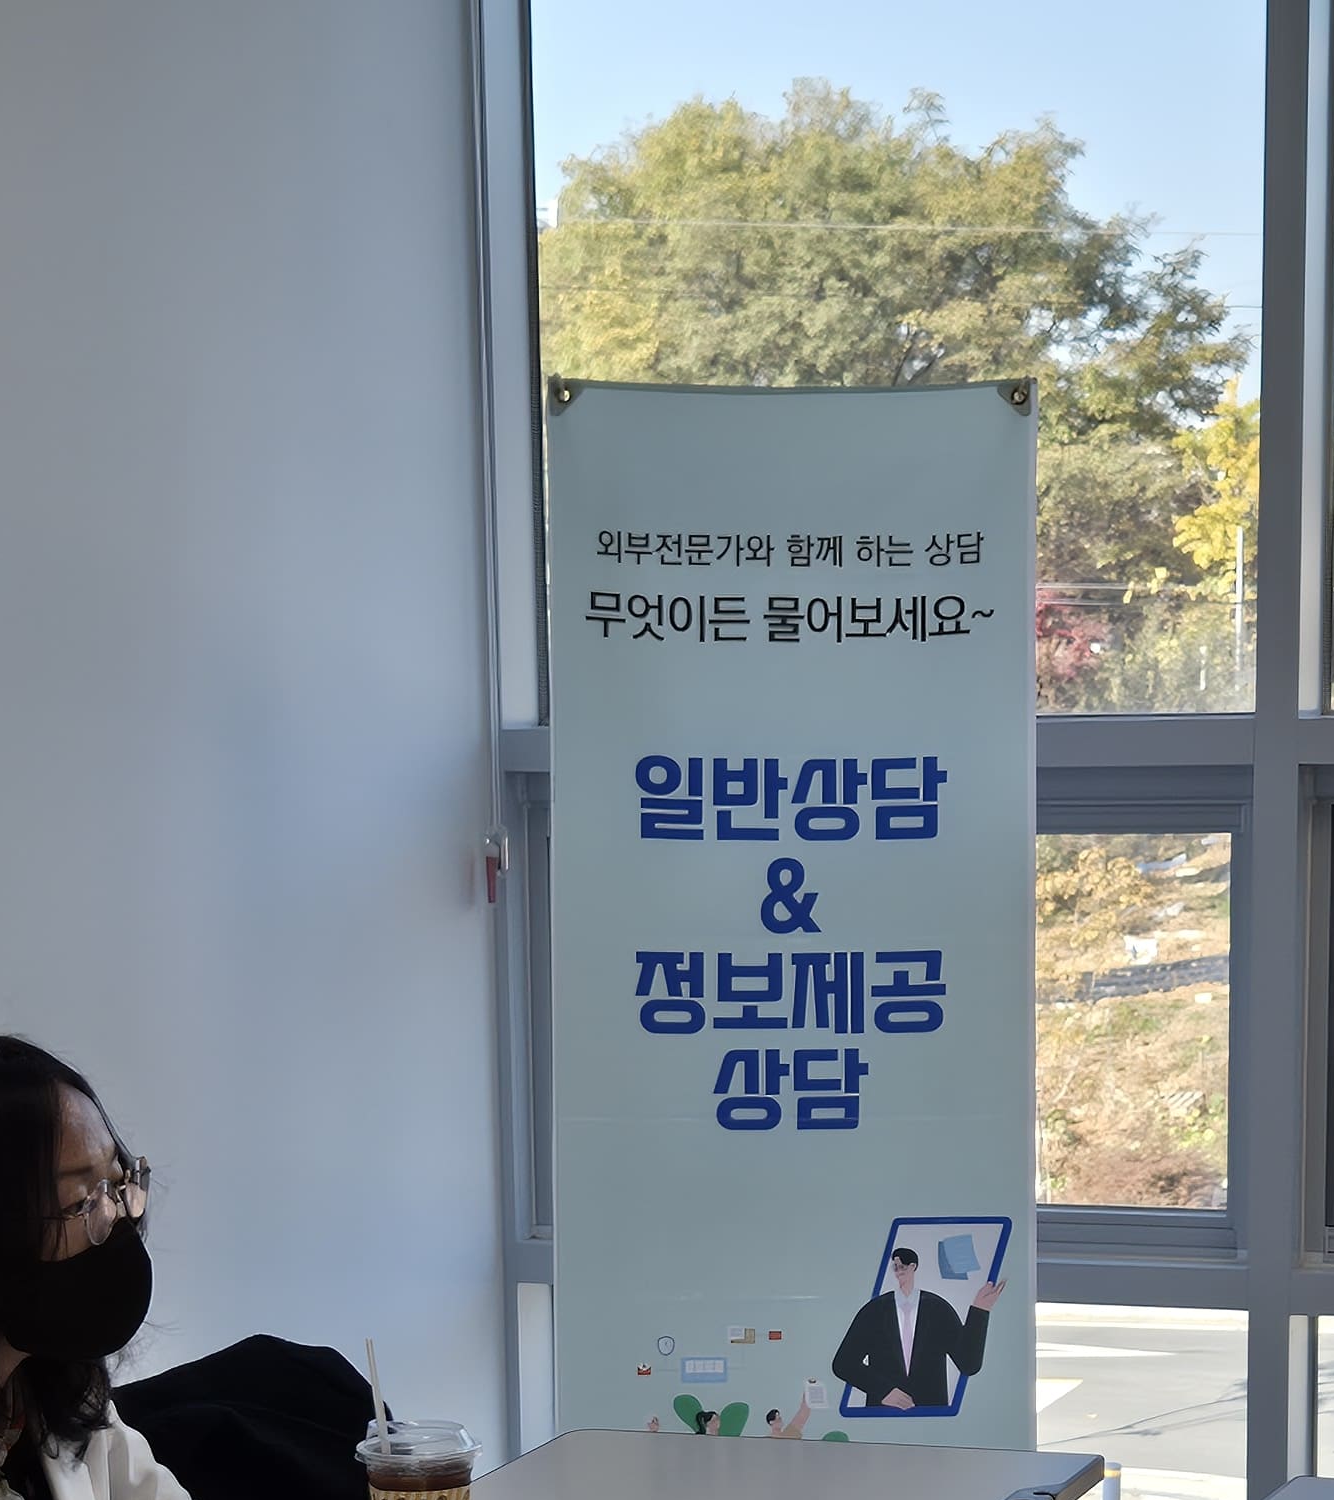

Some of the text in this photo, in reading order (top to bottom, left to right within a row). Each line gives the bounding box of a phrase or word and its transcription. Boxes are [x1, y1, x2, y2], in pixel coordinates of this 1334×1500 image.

[596, 530, 985, 568] 외부전문가와 함께 하는 상담
[584, 591, 995, 644] 무엇이든 물어보세요~
[634, 754, 948, 842] 일반상담
[760, 857, 823, 935] &
[634, 949, 947, 1035] 정보제공
[712, 1047, 869, 1131] 상담
